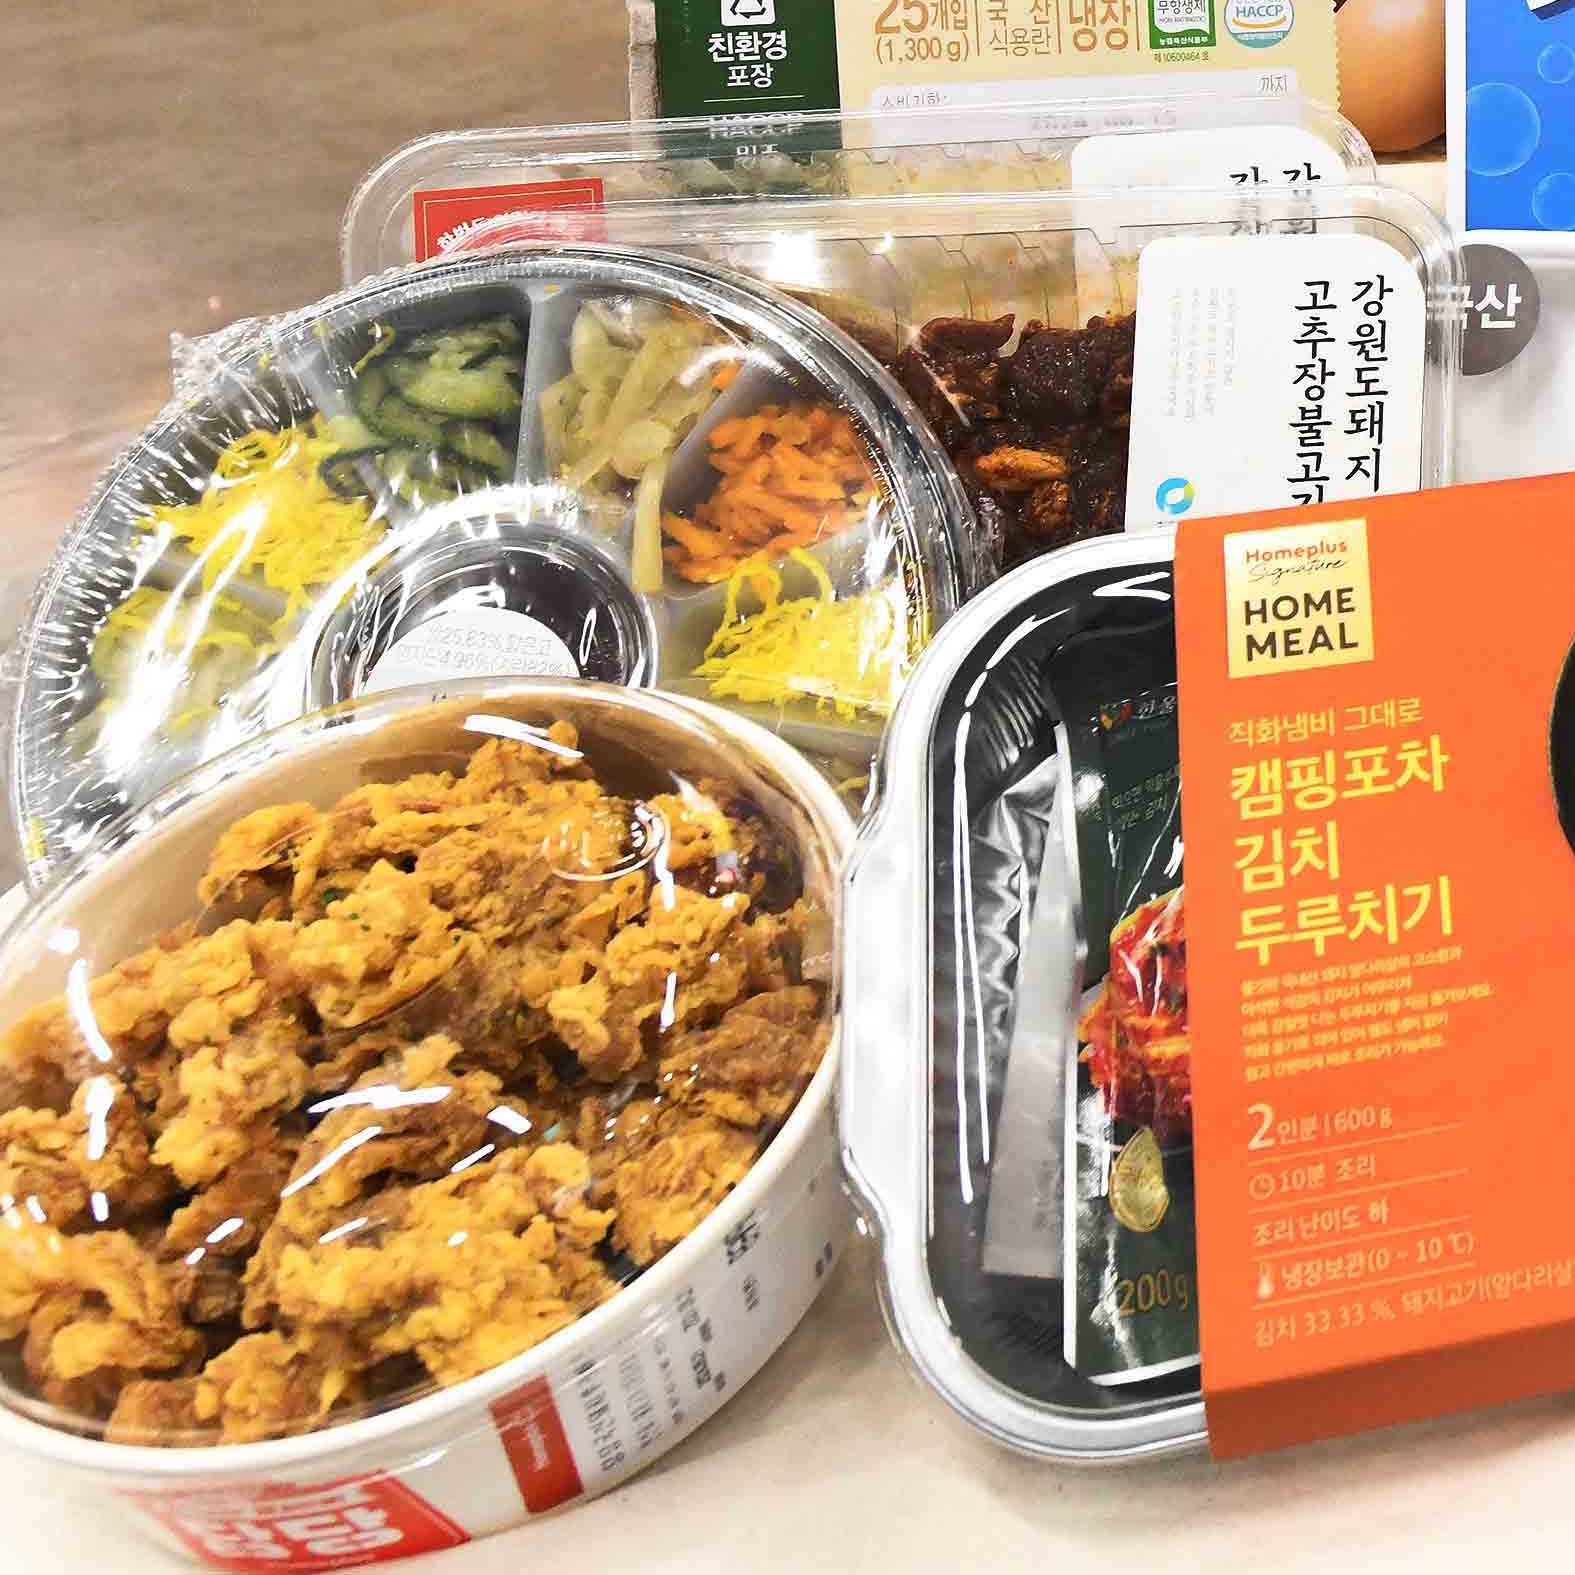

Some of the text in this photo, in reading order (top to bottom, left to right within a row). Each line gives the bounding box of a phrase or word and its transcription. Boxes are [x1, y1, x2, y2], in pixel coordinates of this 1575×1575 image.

[1235, 4, 1285, 19] HACCP
[708, 31, 788, 62] 친환경
[988, 27, 1052, 56] 식용란
[727, 63, 774, 88] 포장
[1260, 75, 1288, 93] 까지
[1246, 540, 1348, 564] Homeplus
[1248, 559, 1347, 585] Signature
[1244, 587, 1355, 626] HOME
[1246, 623, 1359, 662] MEAL
[1229, 698, 1423, 744] 직화냄비 그대로
[1230, 736, 1450, 819] 캠핑포차
[1233, 821, 1342, 893] 김치
[1234, 876, 1455, 967] 두루치기
[1247, 1103, 1319, 1151] 2인분
[1279, 1154, 1376, 1191] 10분 조리
[1253, 1200, 1389, 1246] 조리 난이도 하
[1256, 1319, 1296, 1347] 김치
[1303, 1304, 1364, 1336] 33.33
